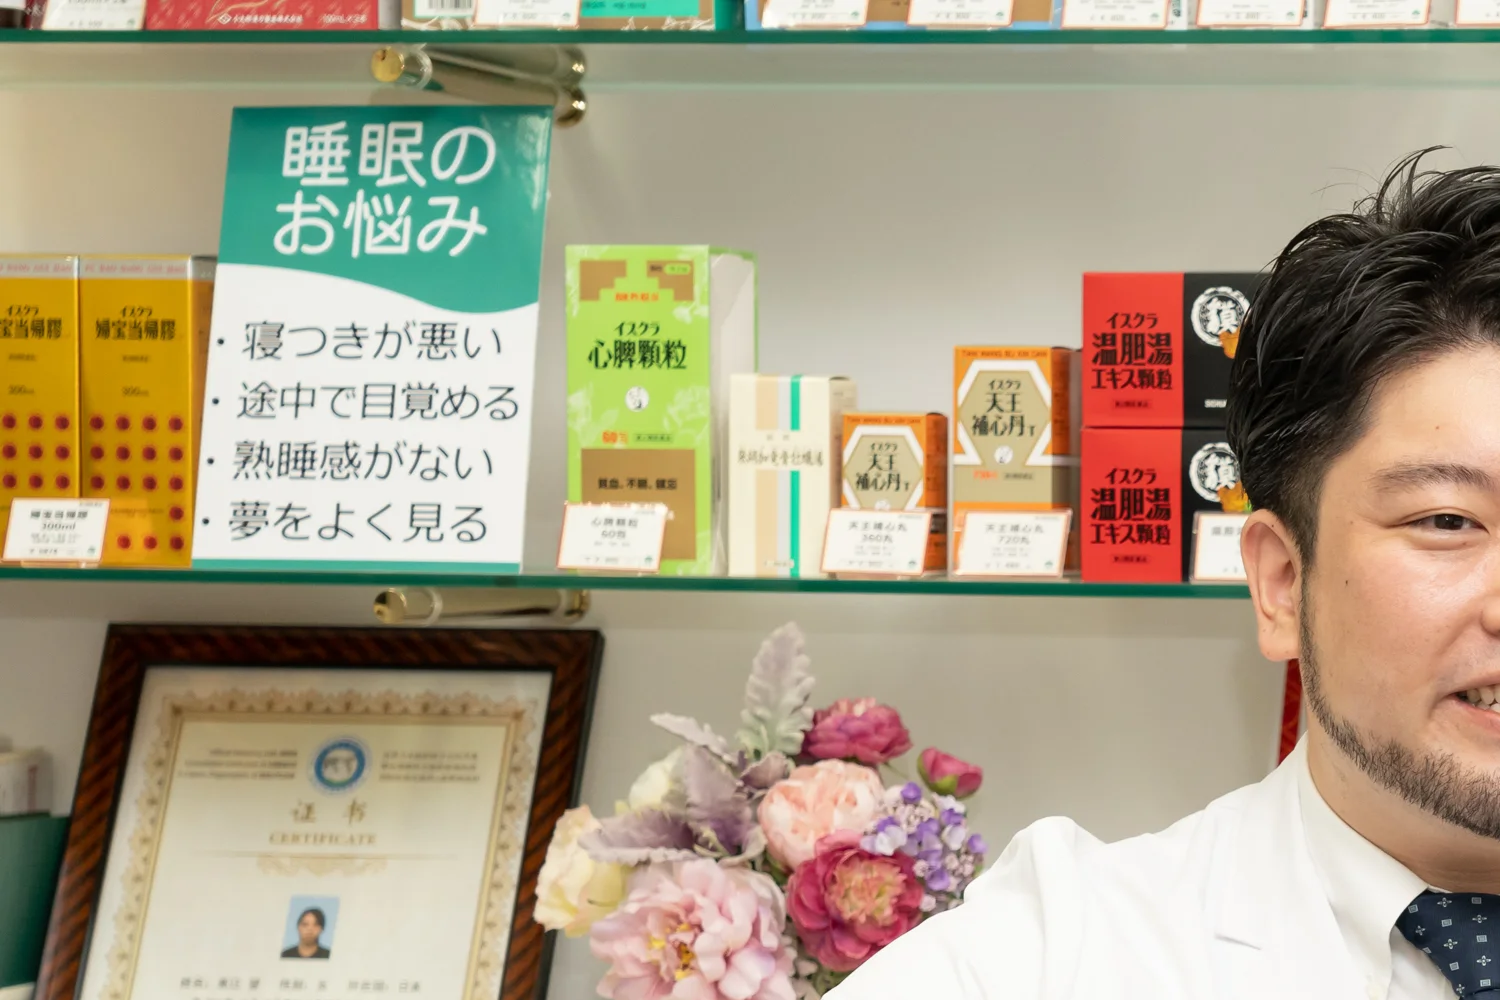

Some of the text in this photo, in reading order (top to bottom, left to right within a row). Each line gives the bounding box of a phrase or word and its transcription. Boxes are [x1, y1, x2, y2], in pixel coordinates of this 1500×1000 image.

[282, 121, 497, 188] 睡眠の
[273, 190, 488, 258] お悩み
[614, 321, 661, 336] イスクラ
[1106, 312, 1159, 329] イスクラ
[241, 320, 504, 362] 寝つきが悪い
[587, 339, 688, 369] 心脾顆粒
[1091, 332, 1173, 366] 温胆湯
[1091, 367, 1173, 390] エキス顆粒
[236, 382, 520, 420] 途中で目覚める
[986, 392, 1023, 413] 天王
[232, 440, 494, 481] 熟睡感がない
[868, 453, 898, 472] 天王
[1105, 467, 1157, 485] イスクラ
[1090, 487, 1172, 521] 温胆湯
[228, 502, 489, 543] 夢をよく見る
[1090, 523, 1172, 546] エキス顆粒
[268, 832, 378, 846] CERTIFICATE
